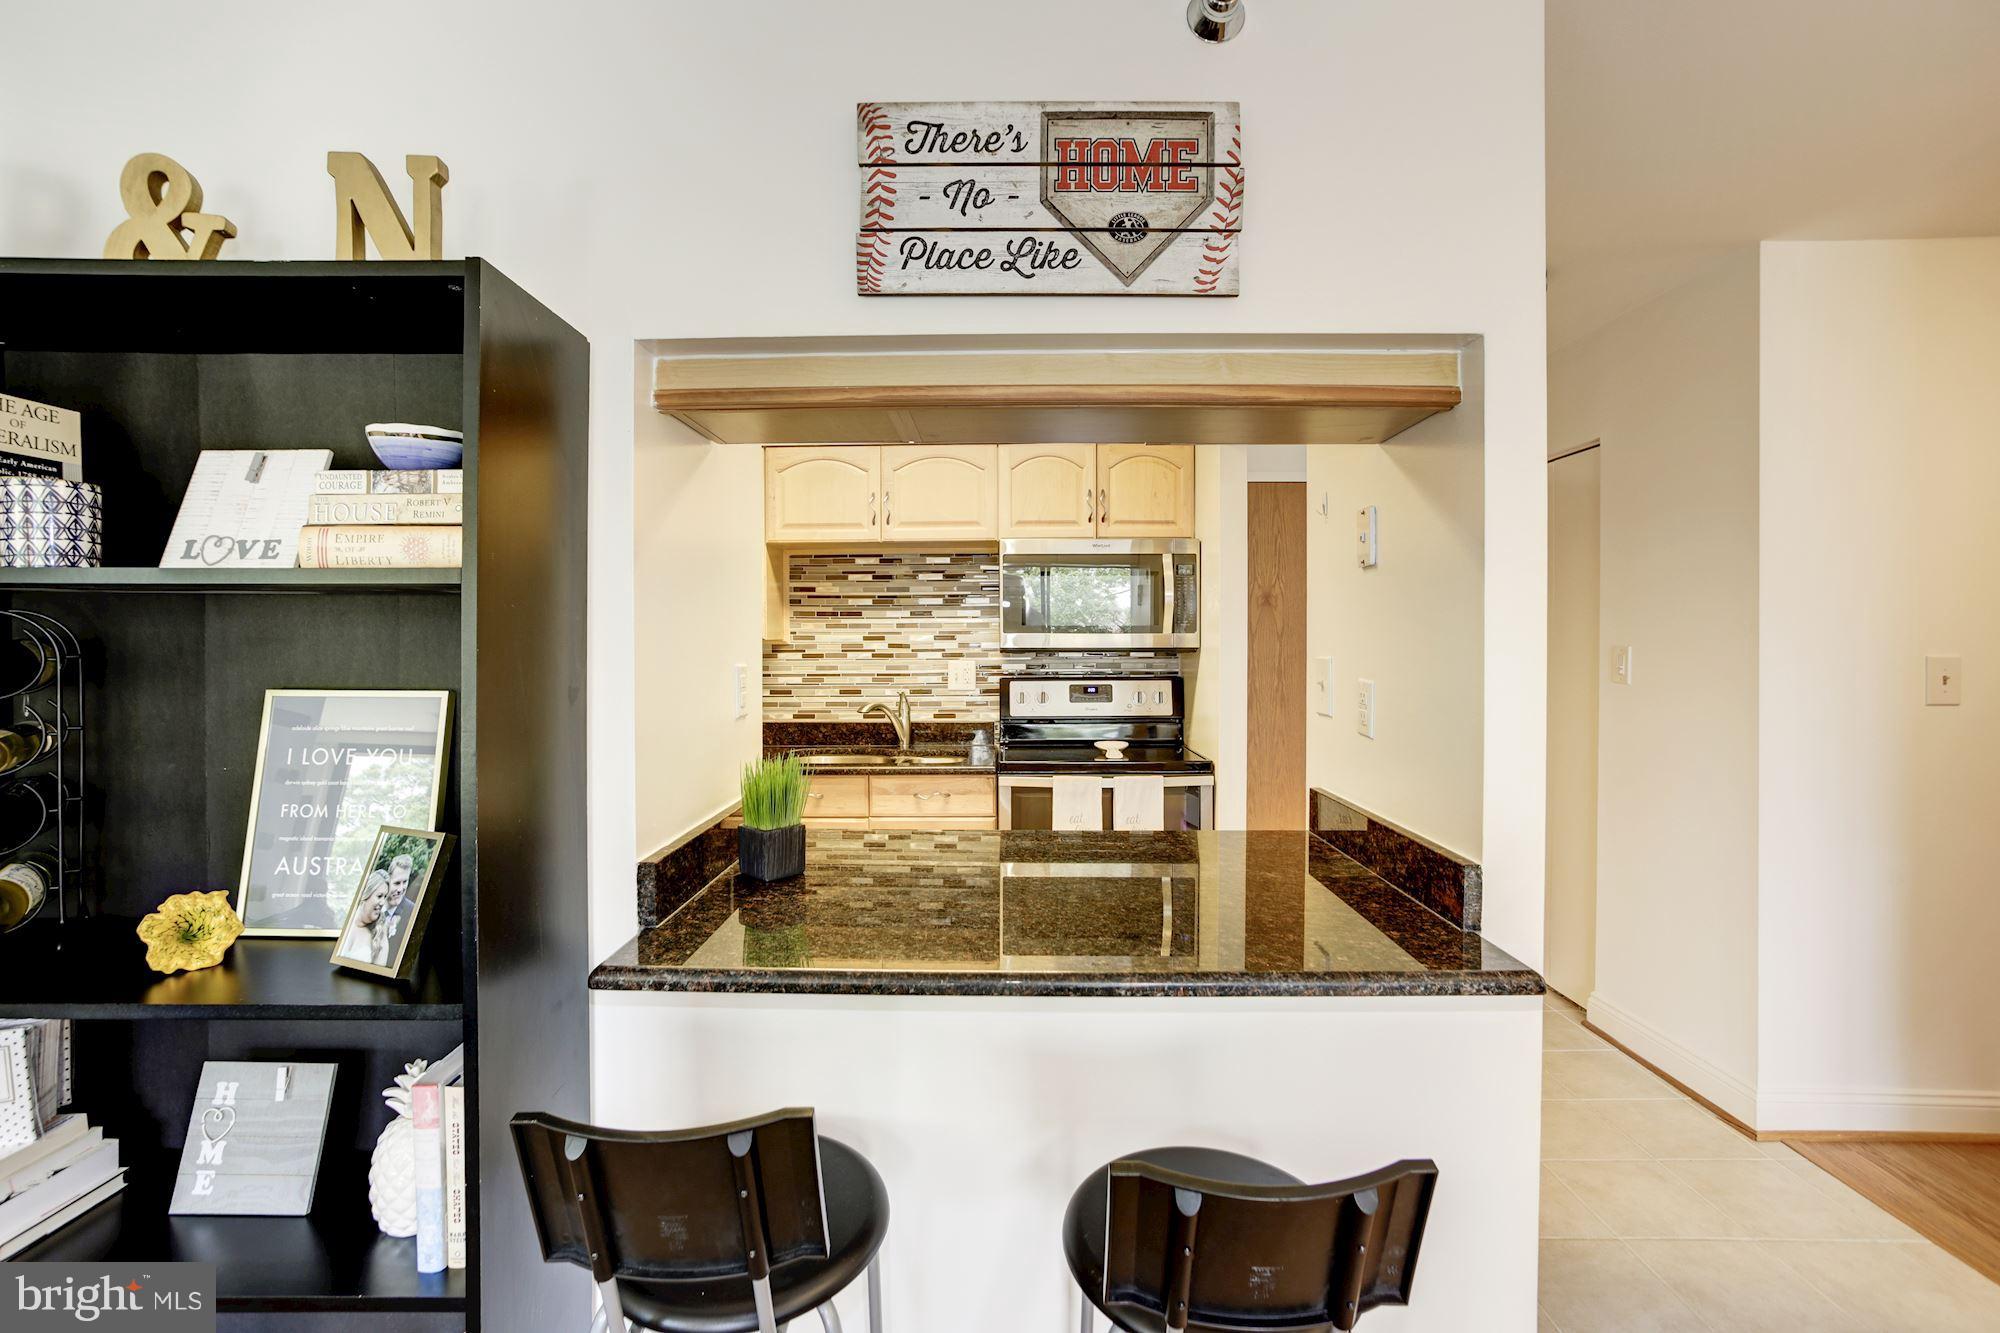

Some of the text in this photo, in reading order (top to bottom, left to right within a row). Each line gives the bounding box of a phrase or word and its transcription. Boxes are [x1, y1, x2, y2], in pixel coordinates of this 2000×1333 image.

[904, 120, 1029, 155] There's
[1054, 137, 1199, 193] HOME
[327, 151, 449, 260] N
[942, 179, 996, 217] No
[899, 236, 1082, 279] Place Like
[21, 404, 60, 424] AGE
[9, 418, 27, 429] OF
[20, 460, 58, 472] American
[318, 472, 363, 481] UNDAUNTED
[319, 480, 363, 490] COURAGE
[406, 498, 441, 507] ROBERT
[314, 502, 397, 522] HOUSE
[413, 510, 446, 519] REMINI
[335, 533, 385, 544] EMPIRE
[335, 555, 393, 566] LIBERTY
[286, 748, 413, 765] I LOVE YOU
[280, 803, 329, 818] FROM
[335, 804, 377, 818] HERE
[274, 856, 364, 876] AUSTRA
